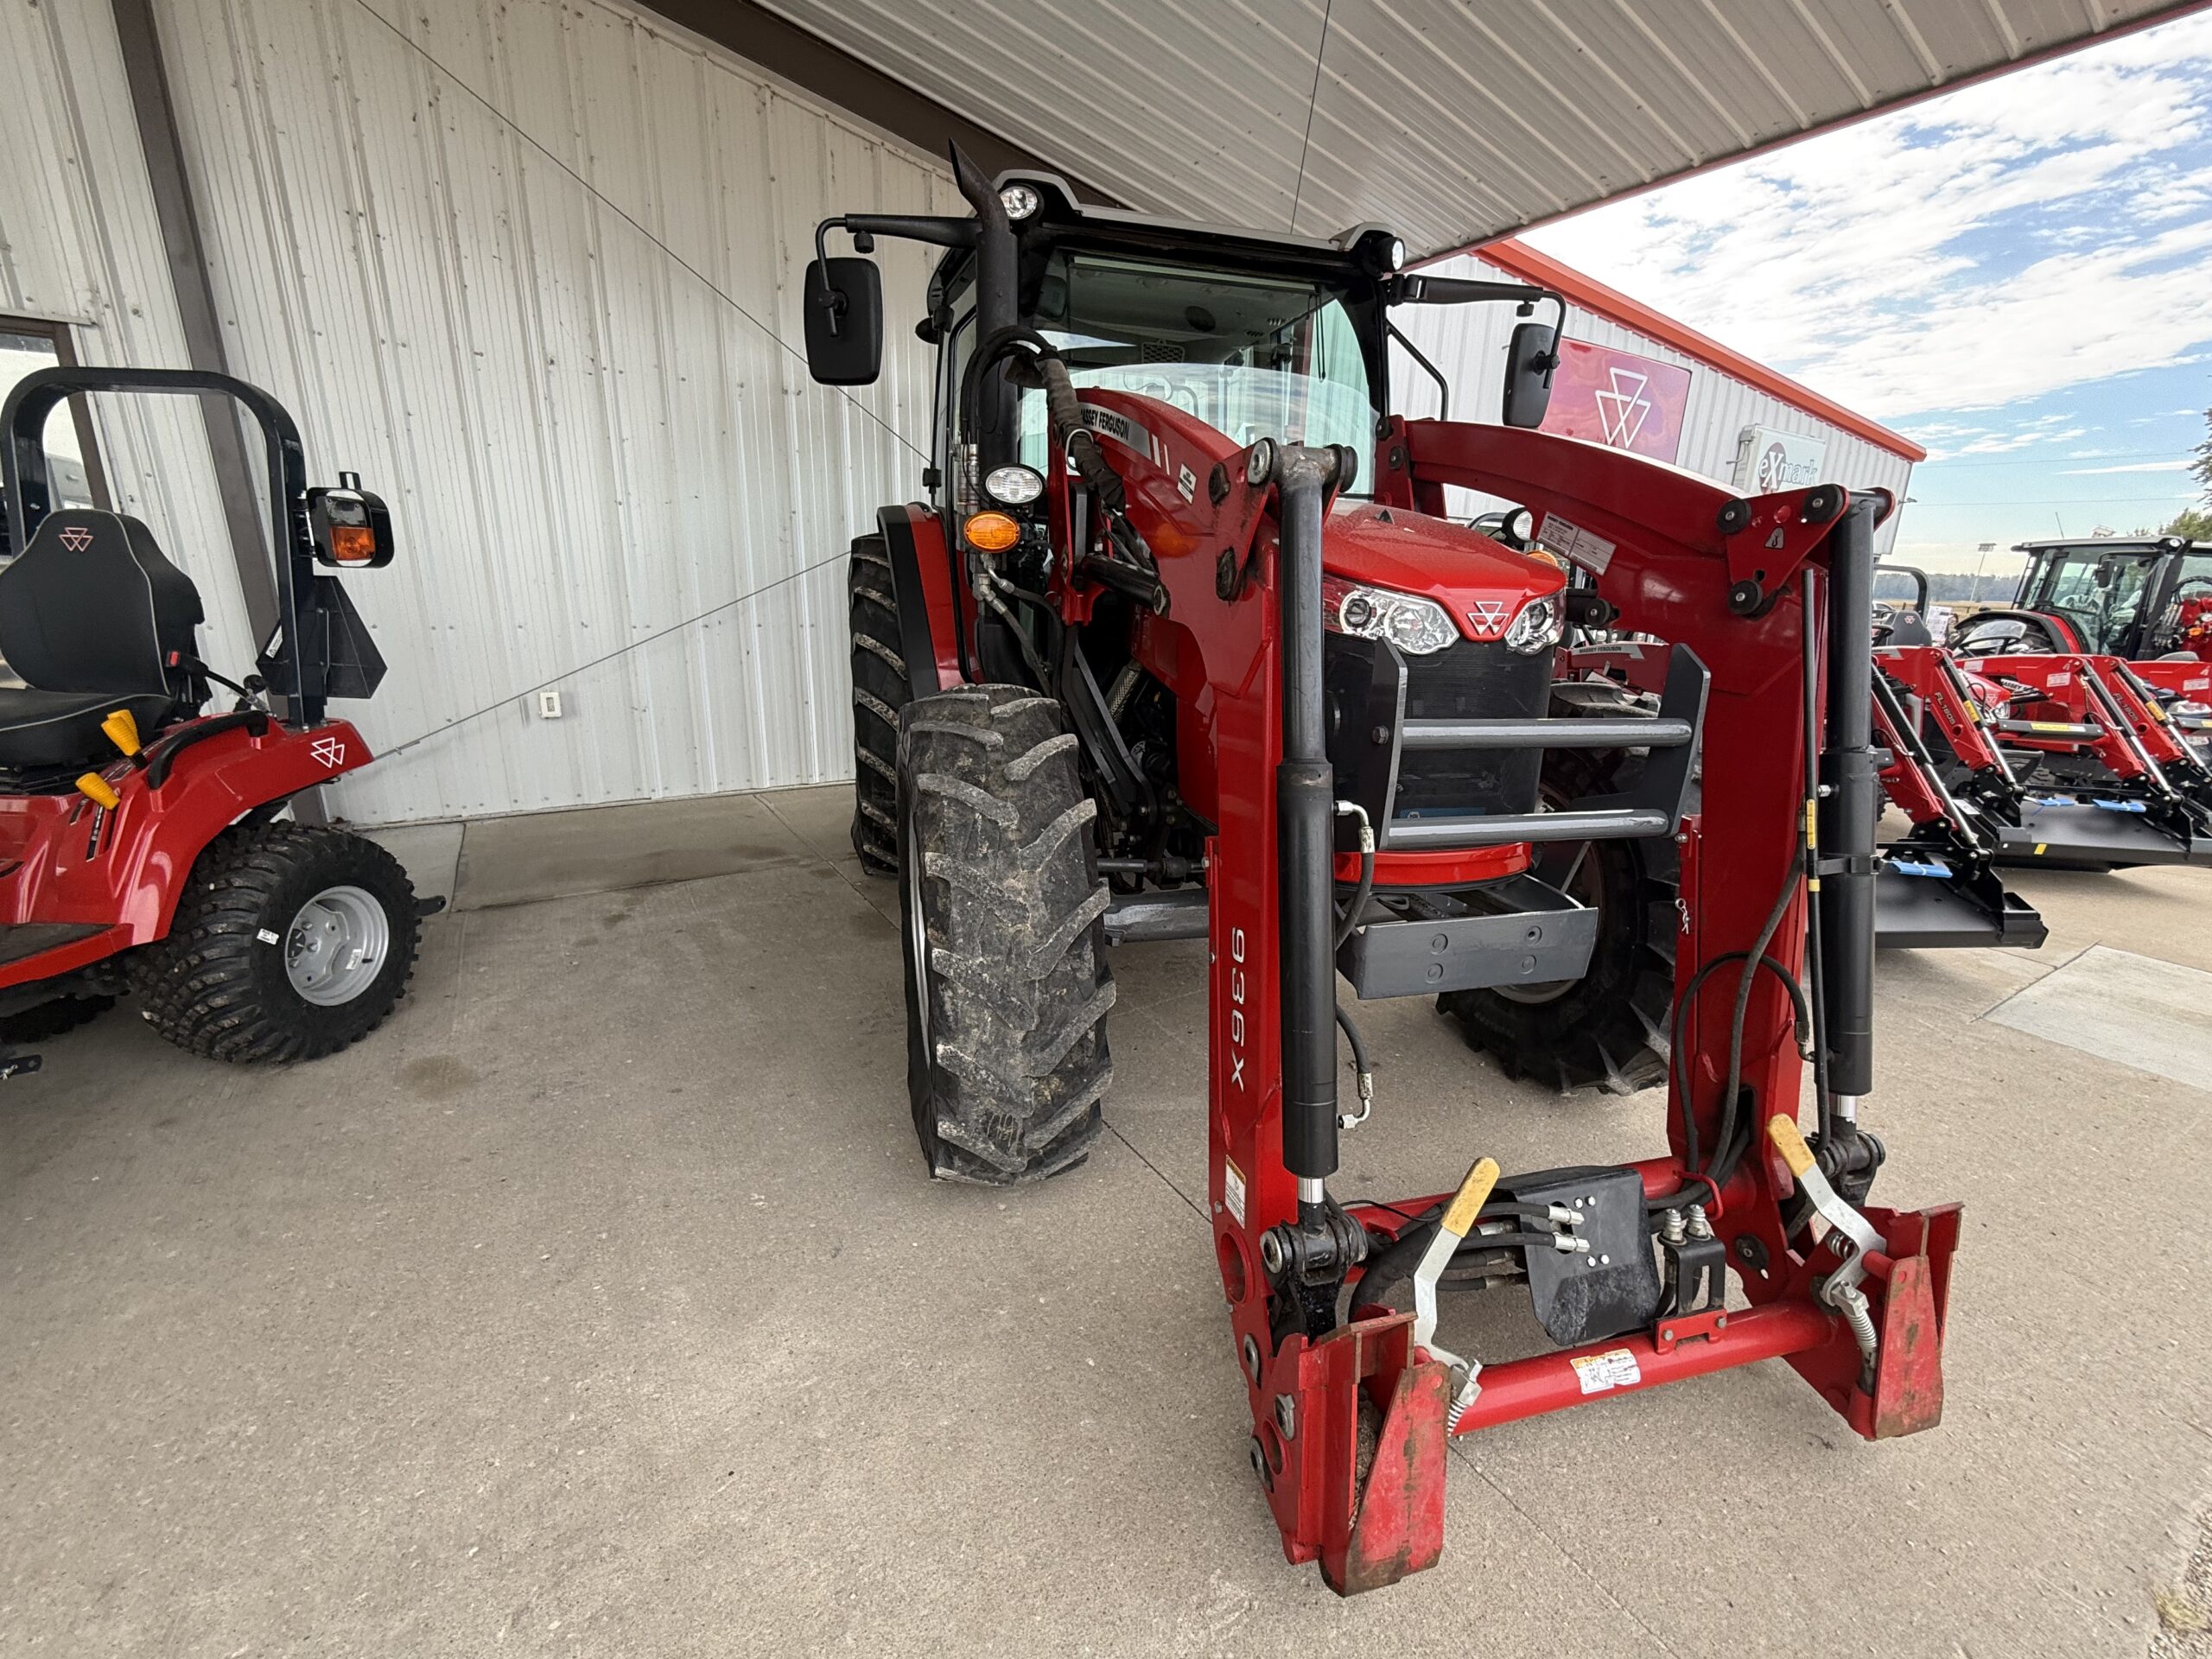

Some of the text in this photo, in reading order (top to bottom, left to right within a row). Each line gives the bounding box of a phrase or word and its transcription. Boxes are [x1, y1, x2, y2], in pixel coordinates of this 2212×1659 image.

[1099, 411, 1129, 440] FERGUSON
[1758, 451, 1818, 489] eXmark
[1231, 927, 1245, 1092] 936X
